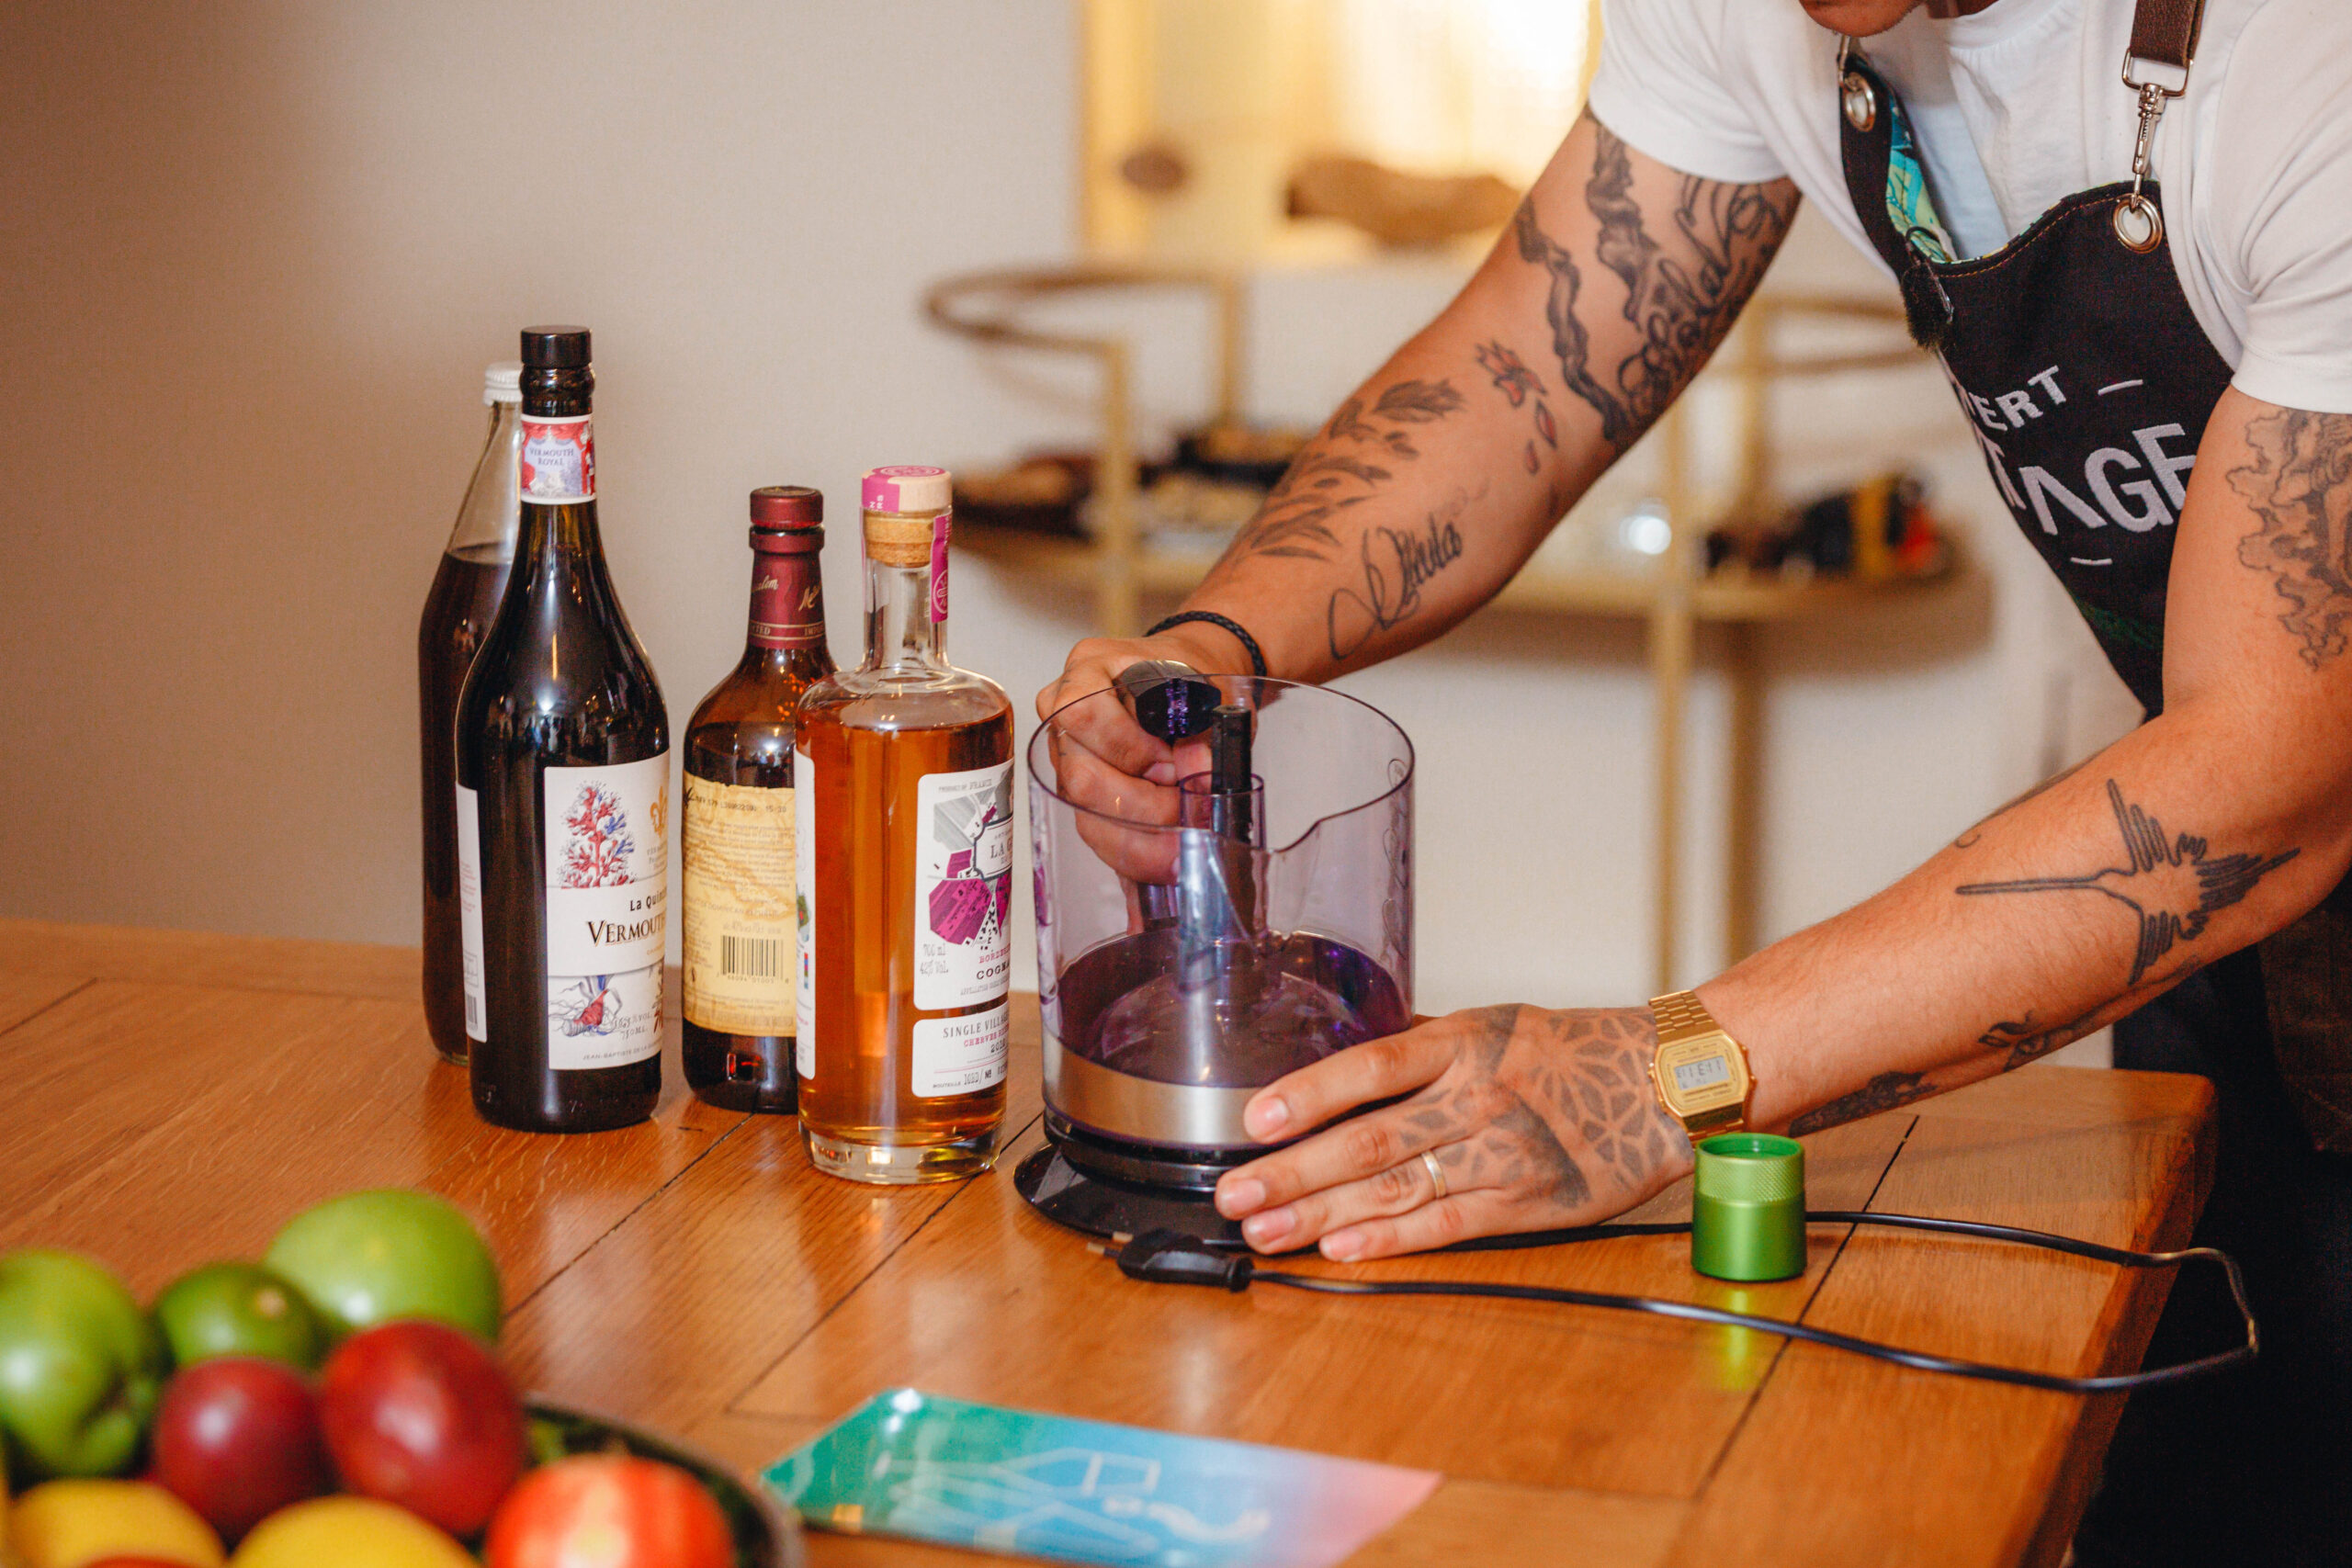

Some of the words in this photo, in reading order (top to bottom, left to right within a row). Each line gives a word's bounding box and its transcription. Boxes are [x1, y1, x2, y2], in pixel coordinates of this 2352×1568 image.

[529, 447, 574, 457] VERMOUTH
[537, 457, 564, 467] ROYAL
[629, 899, 642, 912] La
[943, 1022, 981, 1039] SINGLE
